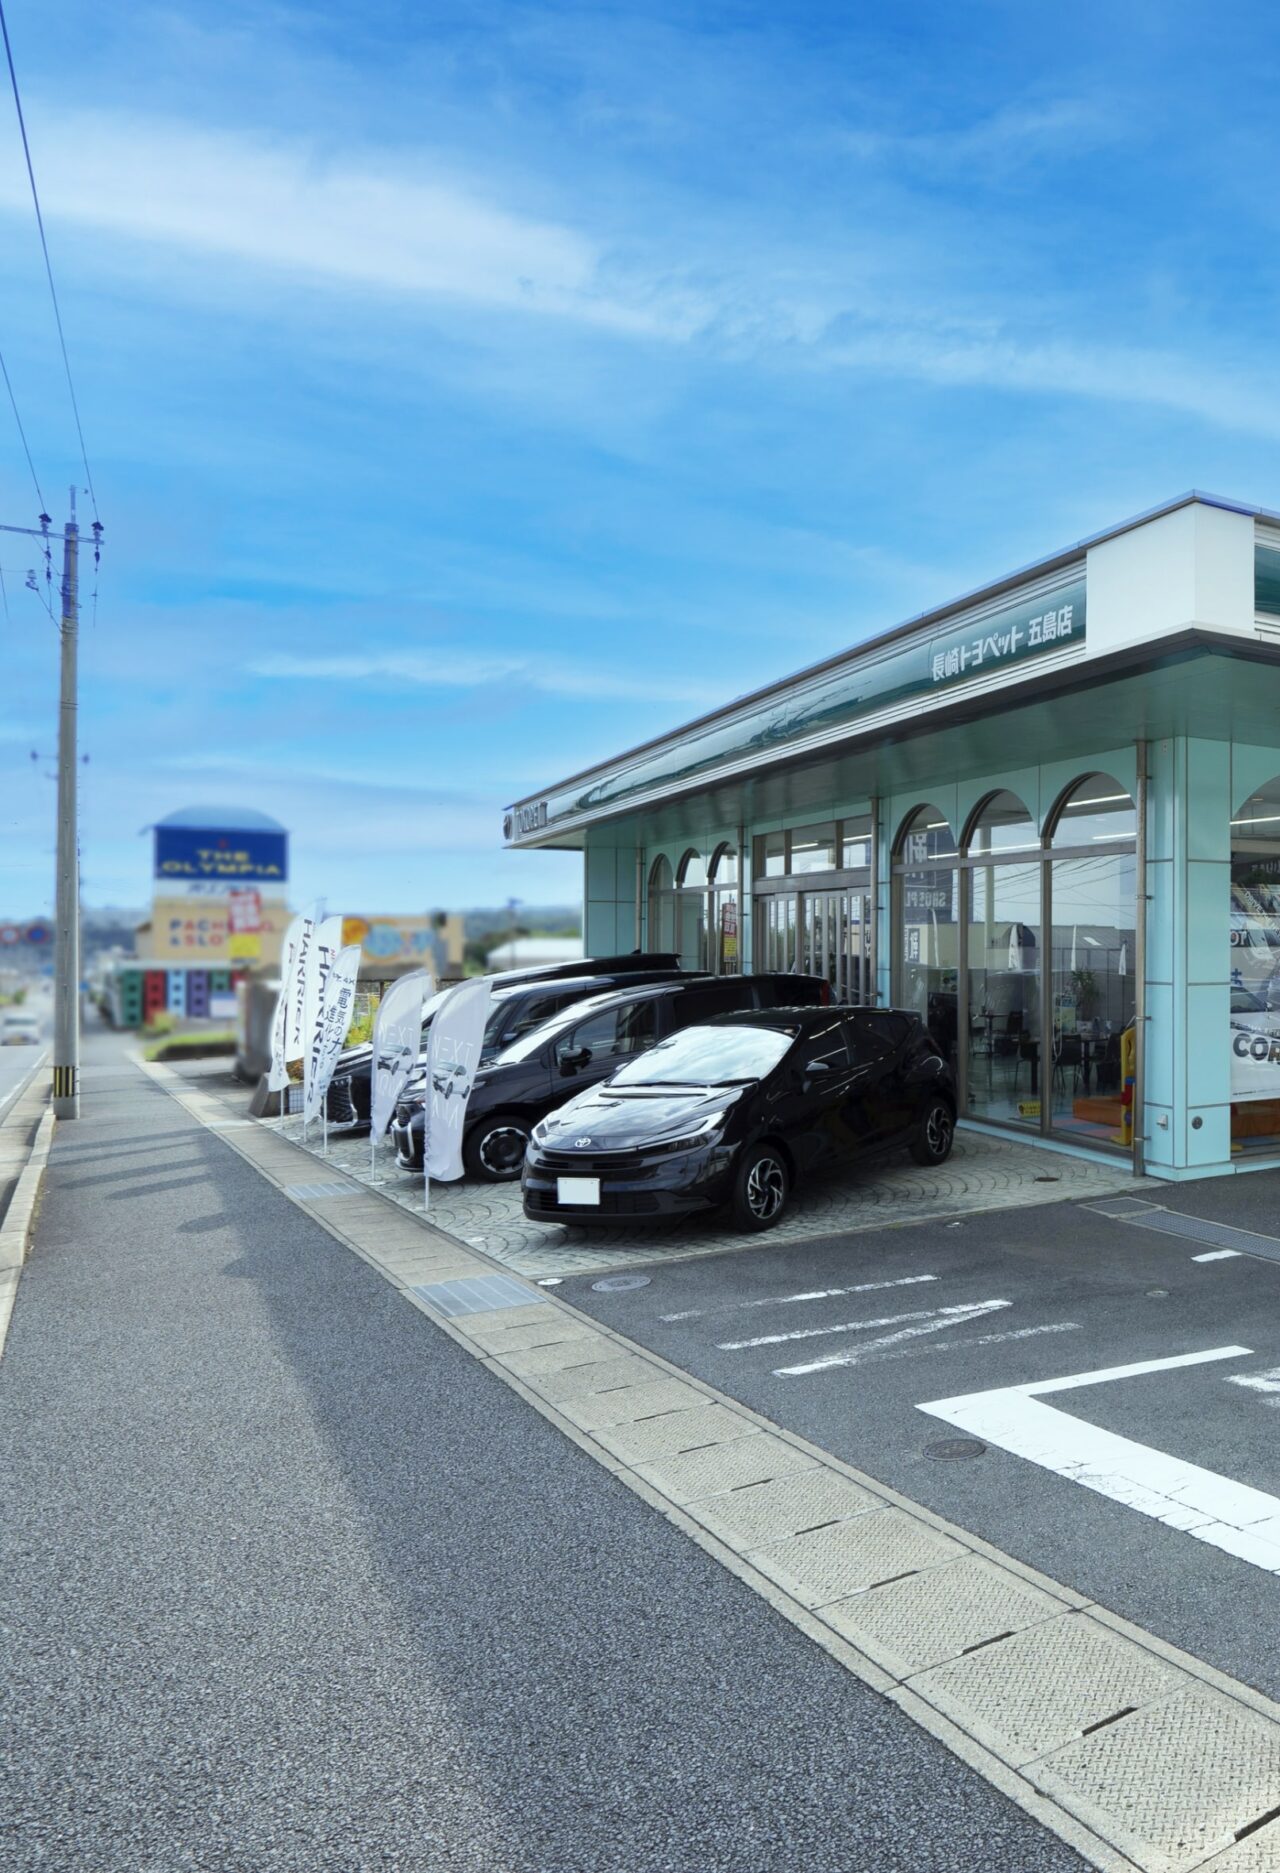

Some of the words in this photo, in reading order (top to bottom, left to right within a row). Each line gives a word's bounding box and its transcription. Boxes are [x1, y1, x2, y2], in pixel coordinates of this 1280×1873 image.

[931, 625, 1024, 682] 長崎トヨペット
[1028, 604, 1073, 647] 五島店
[197, 849, 251, 862] THE
[162, 860, 281, 875] OLYMPIA
